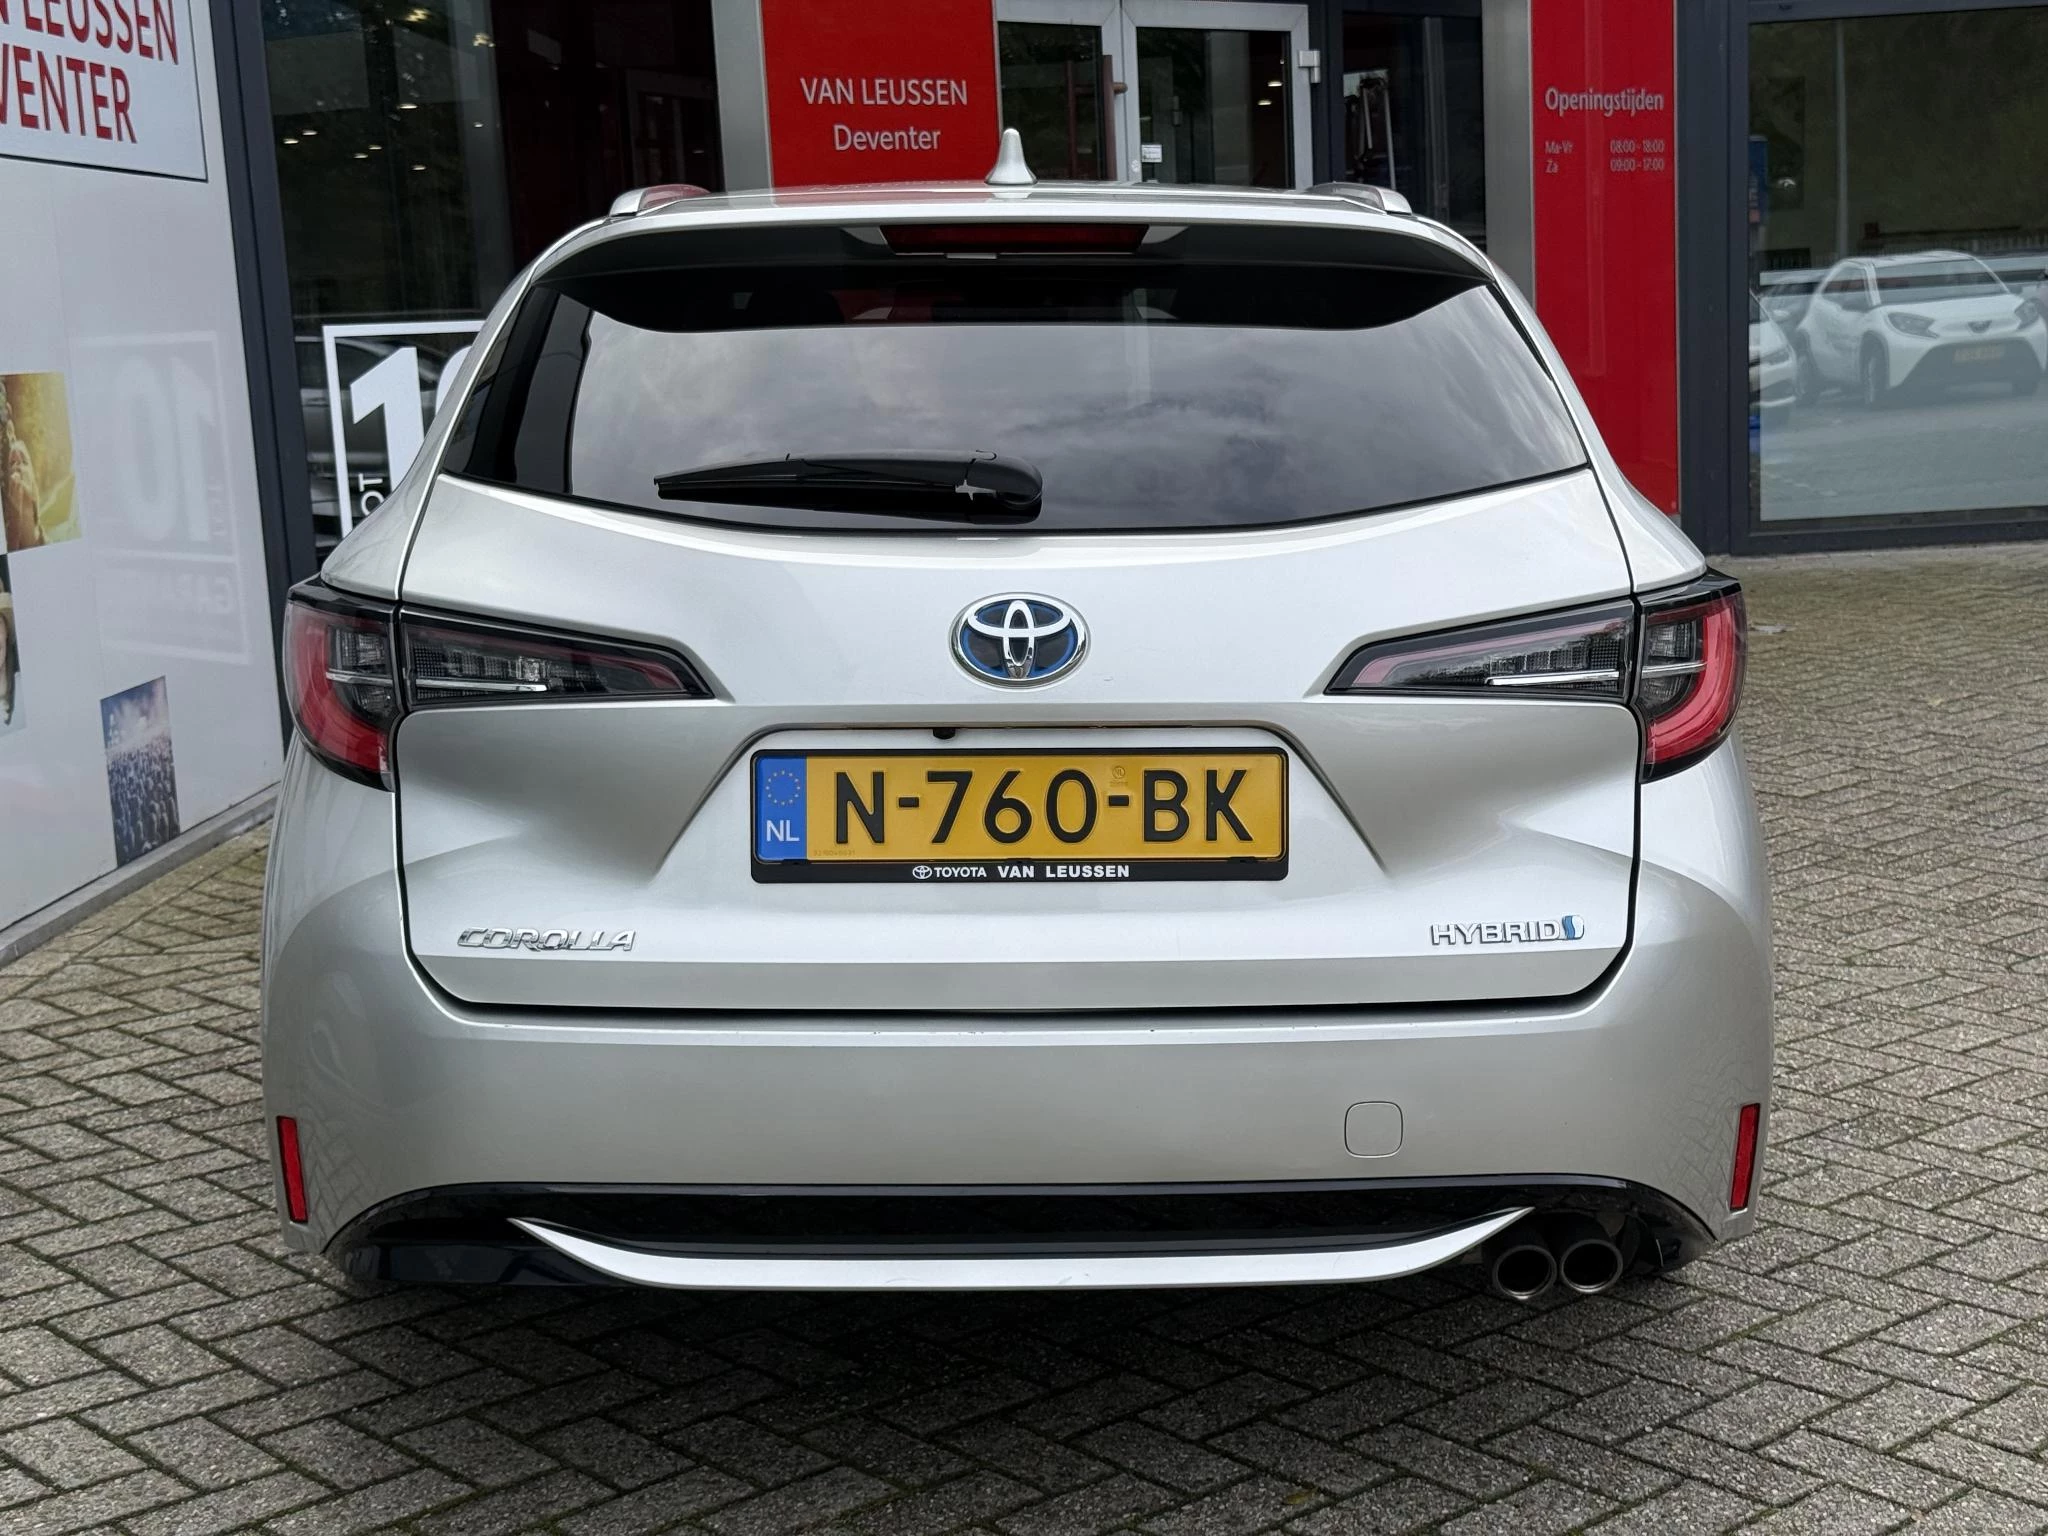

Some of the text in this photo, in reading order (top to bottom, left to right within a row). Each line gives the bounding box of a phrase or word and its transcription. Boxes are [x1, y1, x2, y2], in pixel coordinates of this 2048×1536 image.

[800, 78, 968, 105] VAN LEUSSEN
[1545, 87, 1664, 117] Openingstijden
[834, 124, 941, 150] Deventer
[834, 769, 1254, 844] N-760-BK
[766, 819, 800, 842] NL
[933, 865, 1129, 878] TOYOTA VAN LEUSSEN
[457, 927, 637, 952] COROLLA
[1431, 920, 1561, 946] HYBRID
